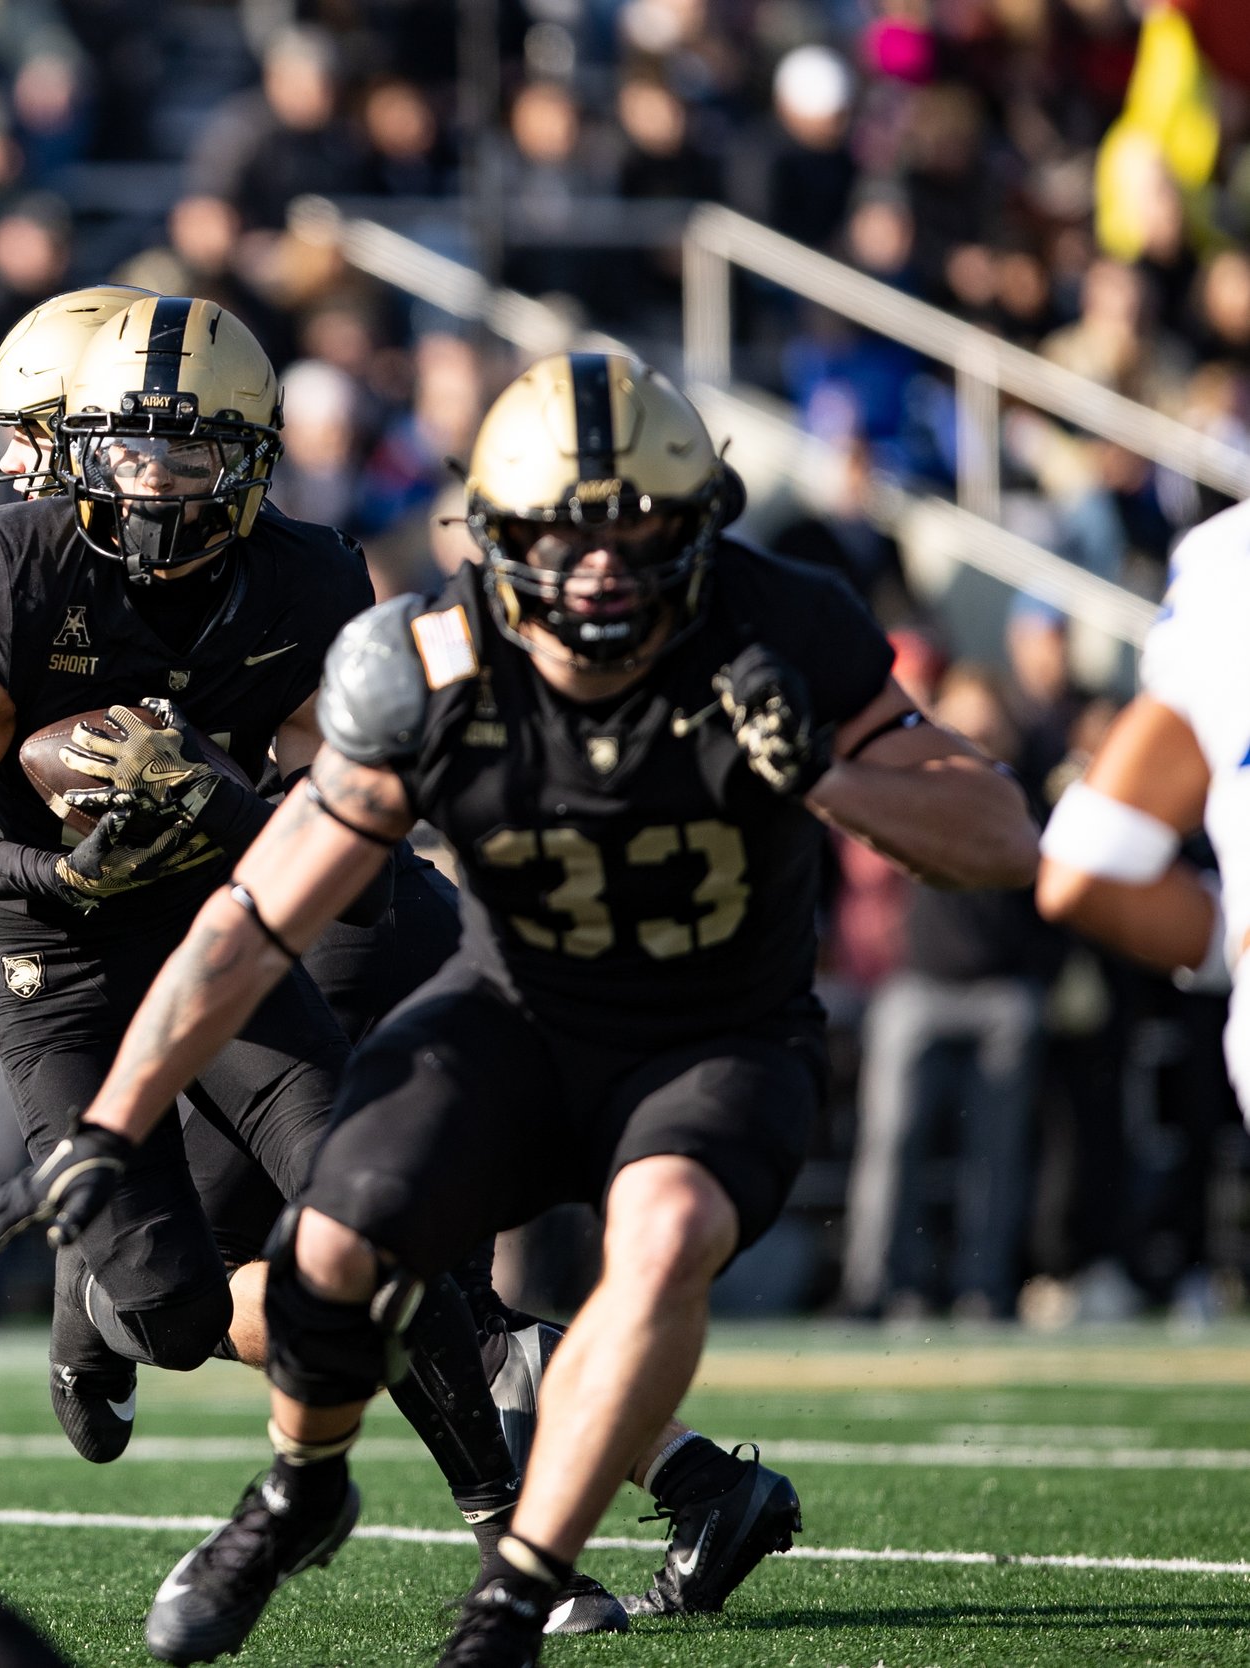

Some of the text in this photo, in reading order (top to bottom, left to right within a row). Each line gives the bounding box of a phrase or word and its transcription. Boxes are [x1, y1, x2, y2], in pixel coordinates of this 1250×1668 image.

[142, 395, 171, 408] ARMY
[53, 605, 91, 647] A
[49, 653, 100, 676] SHORT
[482, 820, 750, 960] 33
